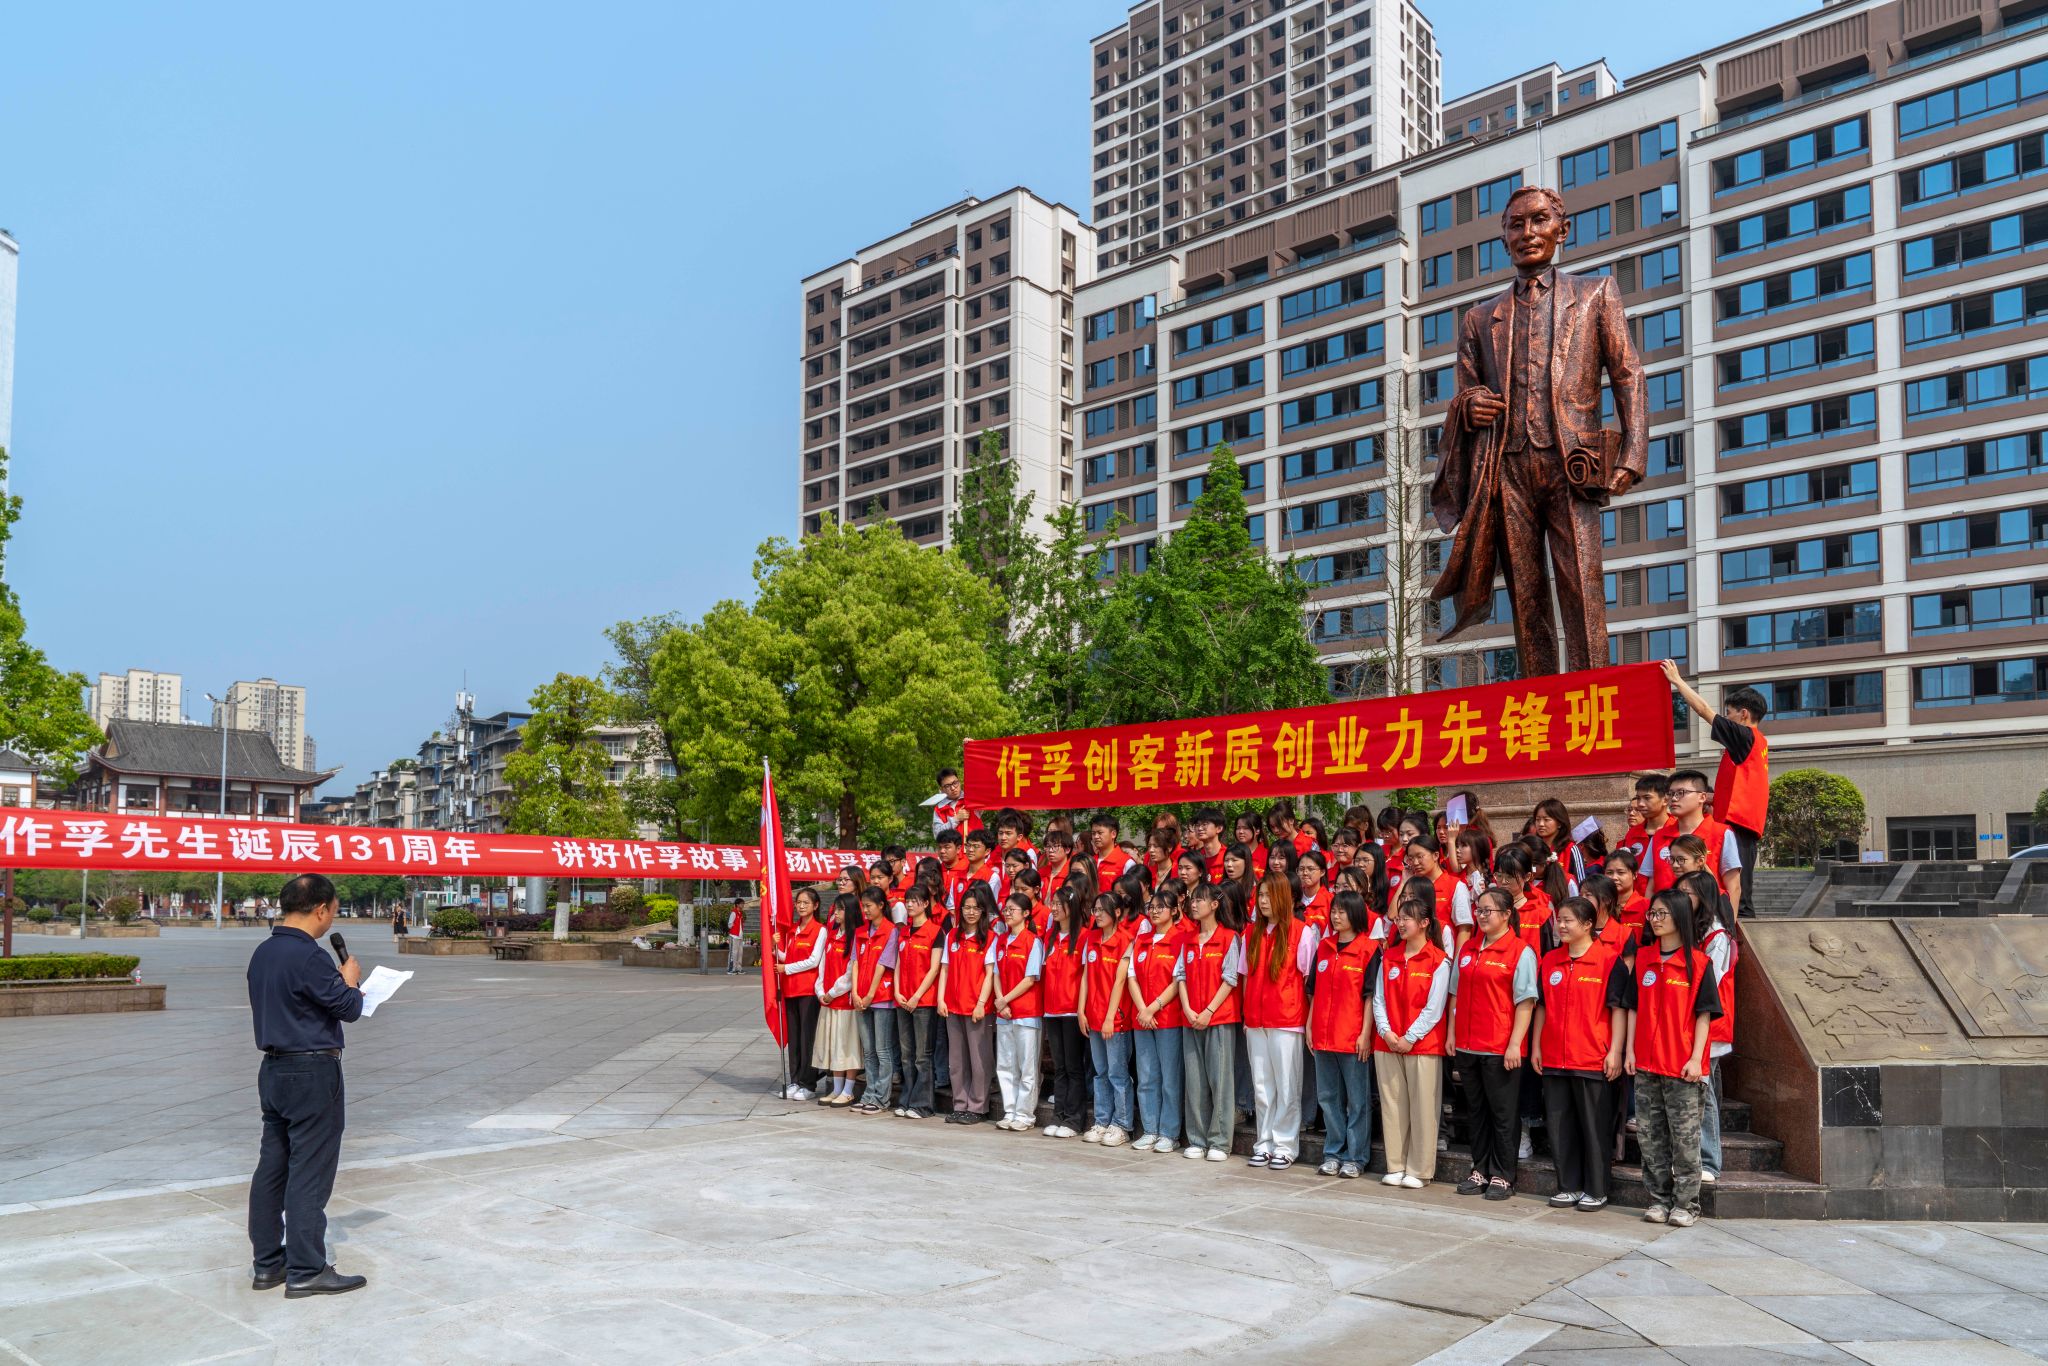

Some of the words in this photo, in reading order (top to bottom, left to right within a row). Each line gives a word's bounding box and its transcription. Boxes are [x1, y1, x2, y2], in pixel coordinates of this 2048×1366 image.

[996, 683, 1623, 798] 作孚创客新质创业力先锋班
